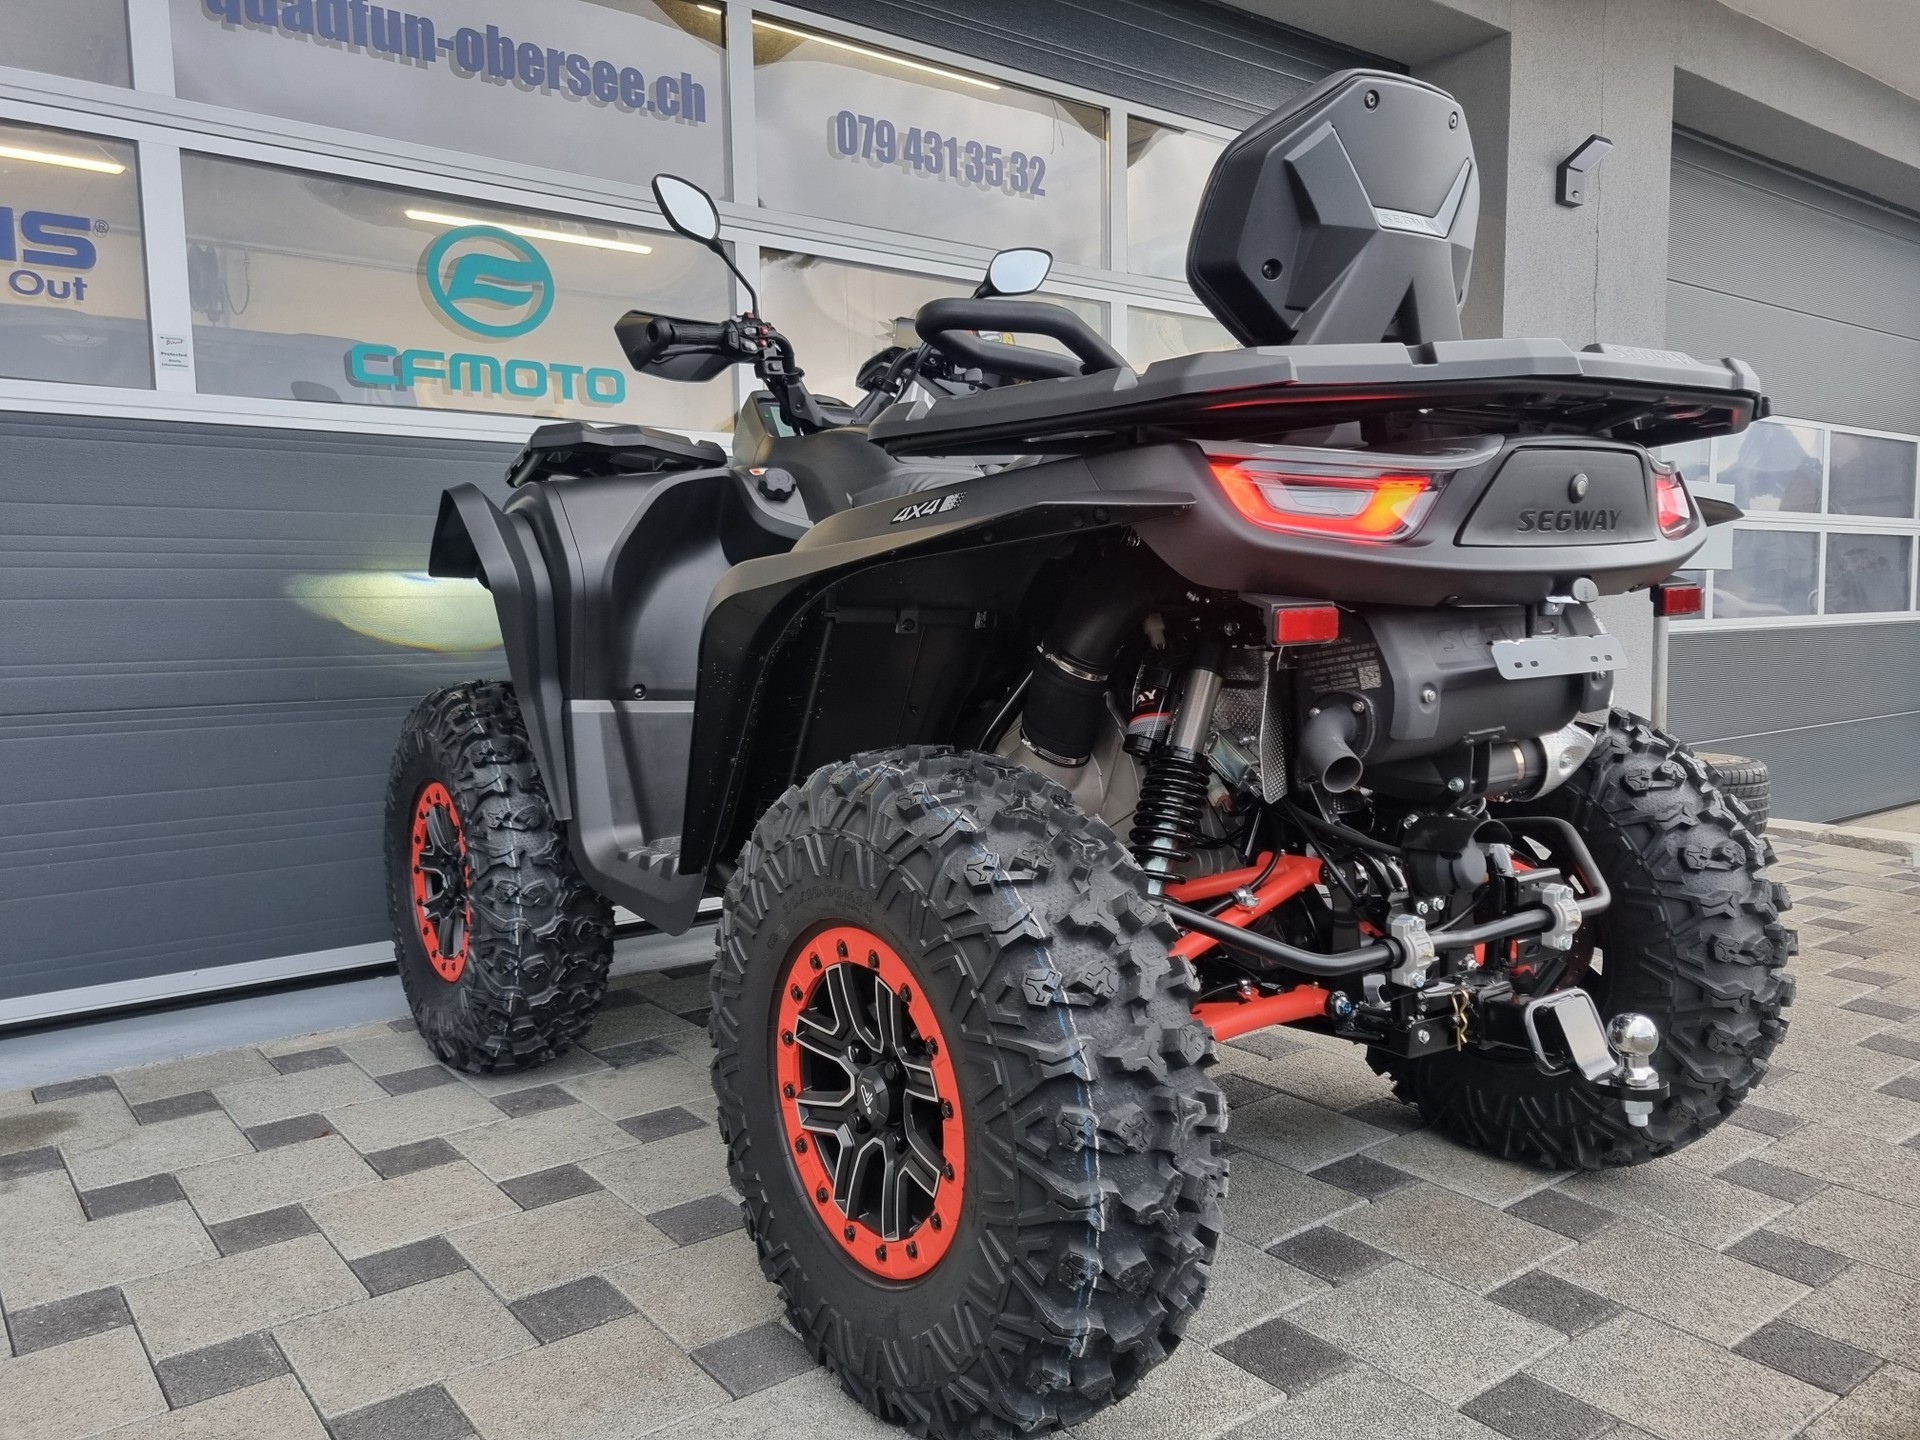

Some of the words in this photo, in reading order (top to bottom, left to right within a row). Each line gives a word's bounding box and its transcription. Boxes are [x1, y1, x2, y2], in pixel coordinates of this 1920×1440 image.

[836, 110, 897, 164] 079
[903, 127, 958, 178] 431
[965, 140, 1004, 187] 35
[1010, 151, 1047, 197] 32
[8, 269, 89, 301] Out
[351, 343, 626, 405] CFMOTO
[1517, 508, 1622, 533] SEGWAY
